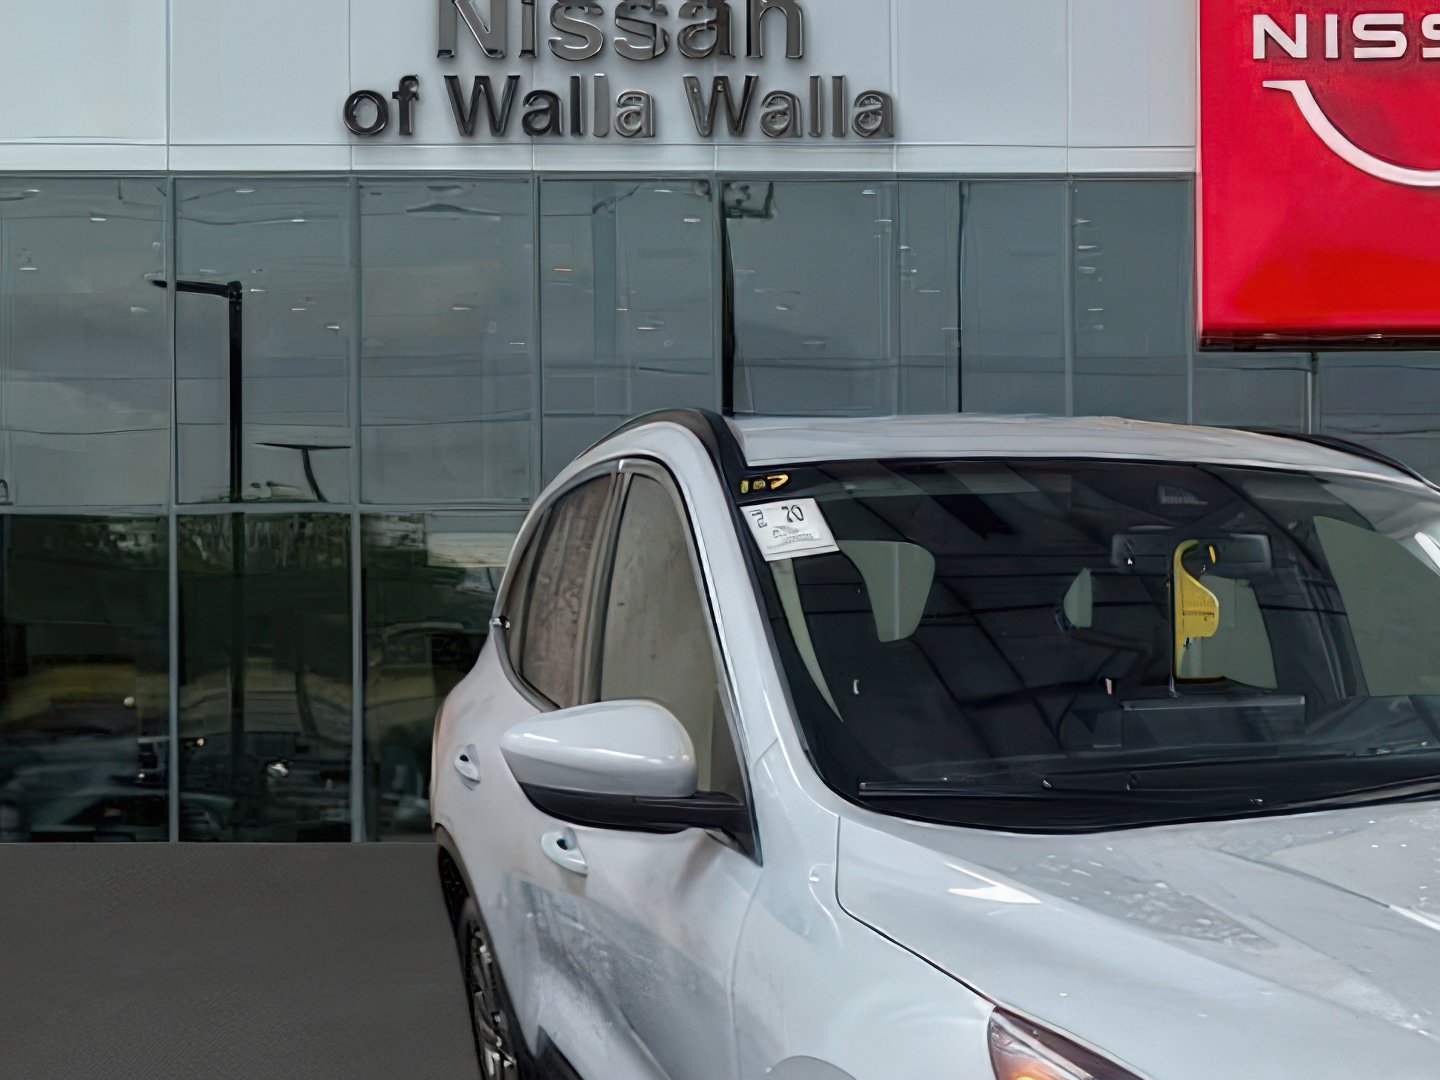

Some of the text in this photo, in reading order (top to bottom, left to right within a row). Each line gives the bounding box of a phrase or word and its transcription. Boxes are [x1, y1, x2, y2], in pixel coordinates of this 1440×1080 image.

[437, 0, 804, 60] Nissan
[343, 74, 895, 138] of Walla Walla
